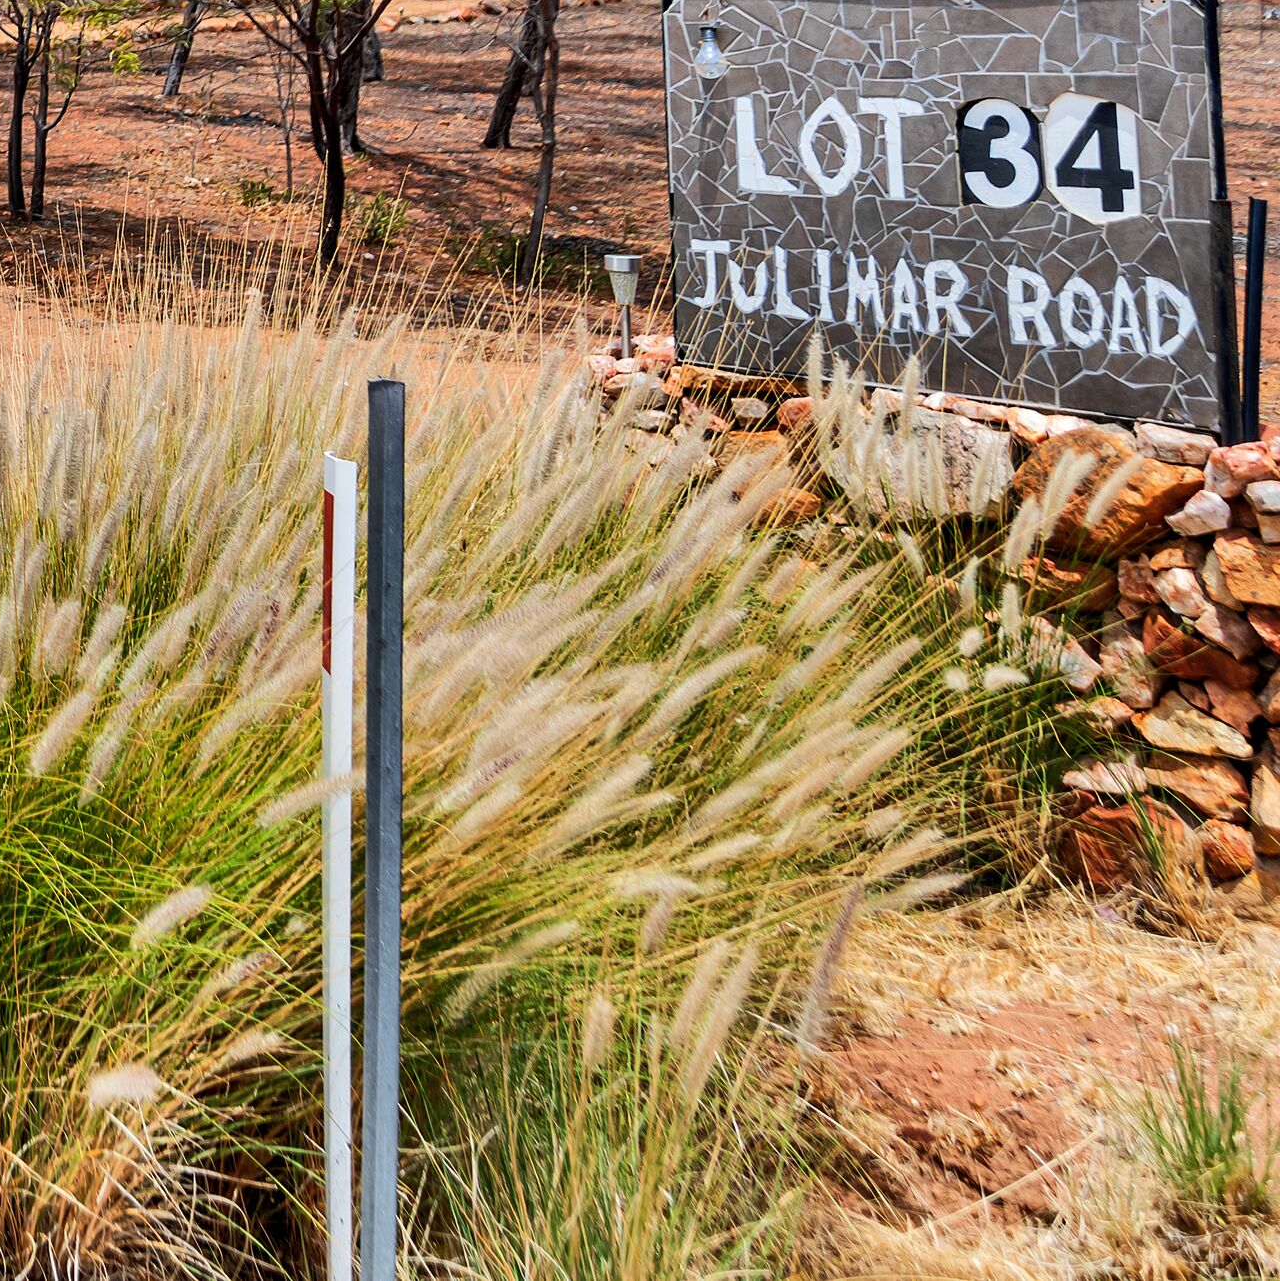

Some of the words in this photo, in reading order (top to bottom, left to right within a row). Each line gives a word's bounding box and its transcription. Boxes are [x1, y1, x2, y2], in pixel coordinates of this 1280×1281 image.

[734, 95, 925, 200] LOT
[962, 97, 1135, 214] 34
[690, 238, 973, 338] JULIMAR
[1006, 263, 1198, 358] ROAD
